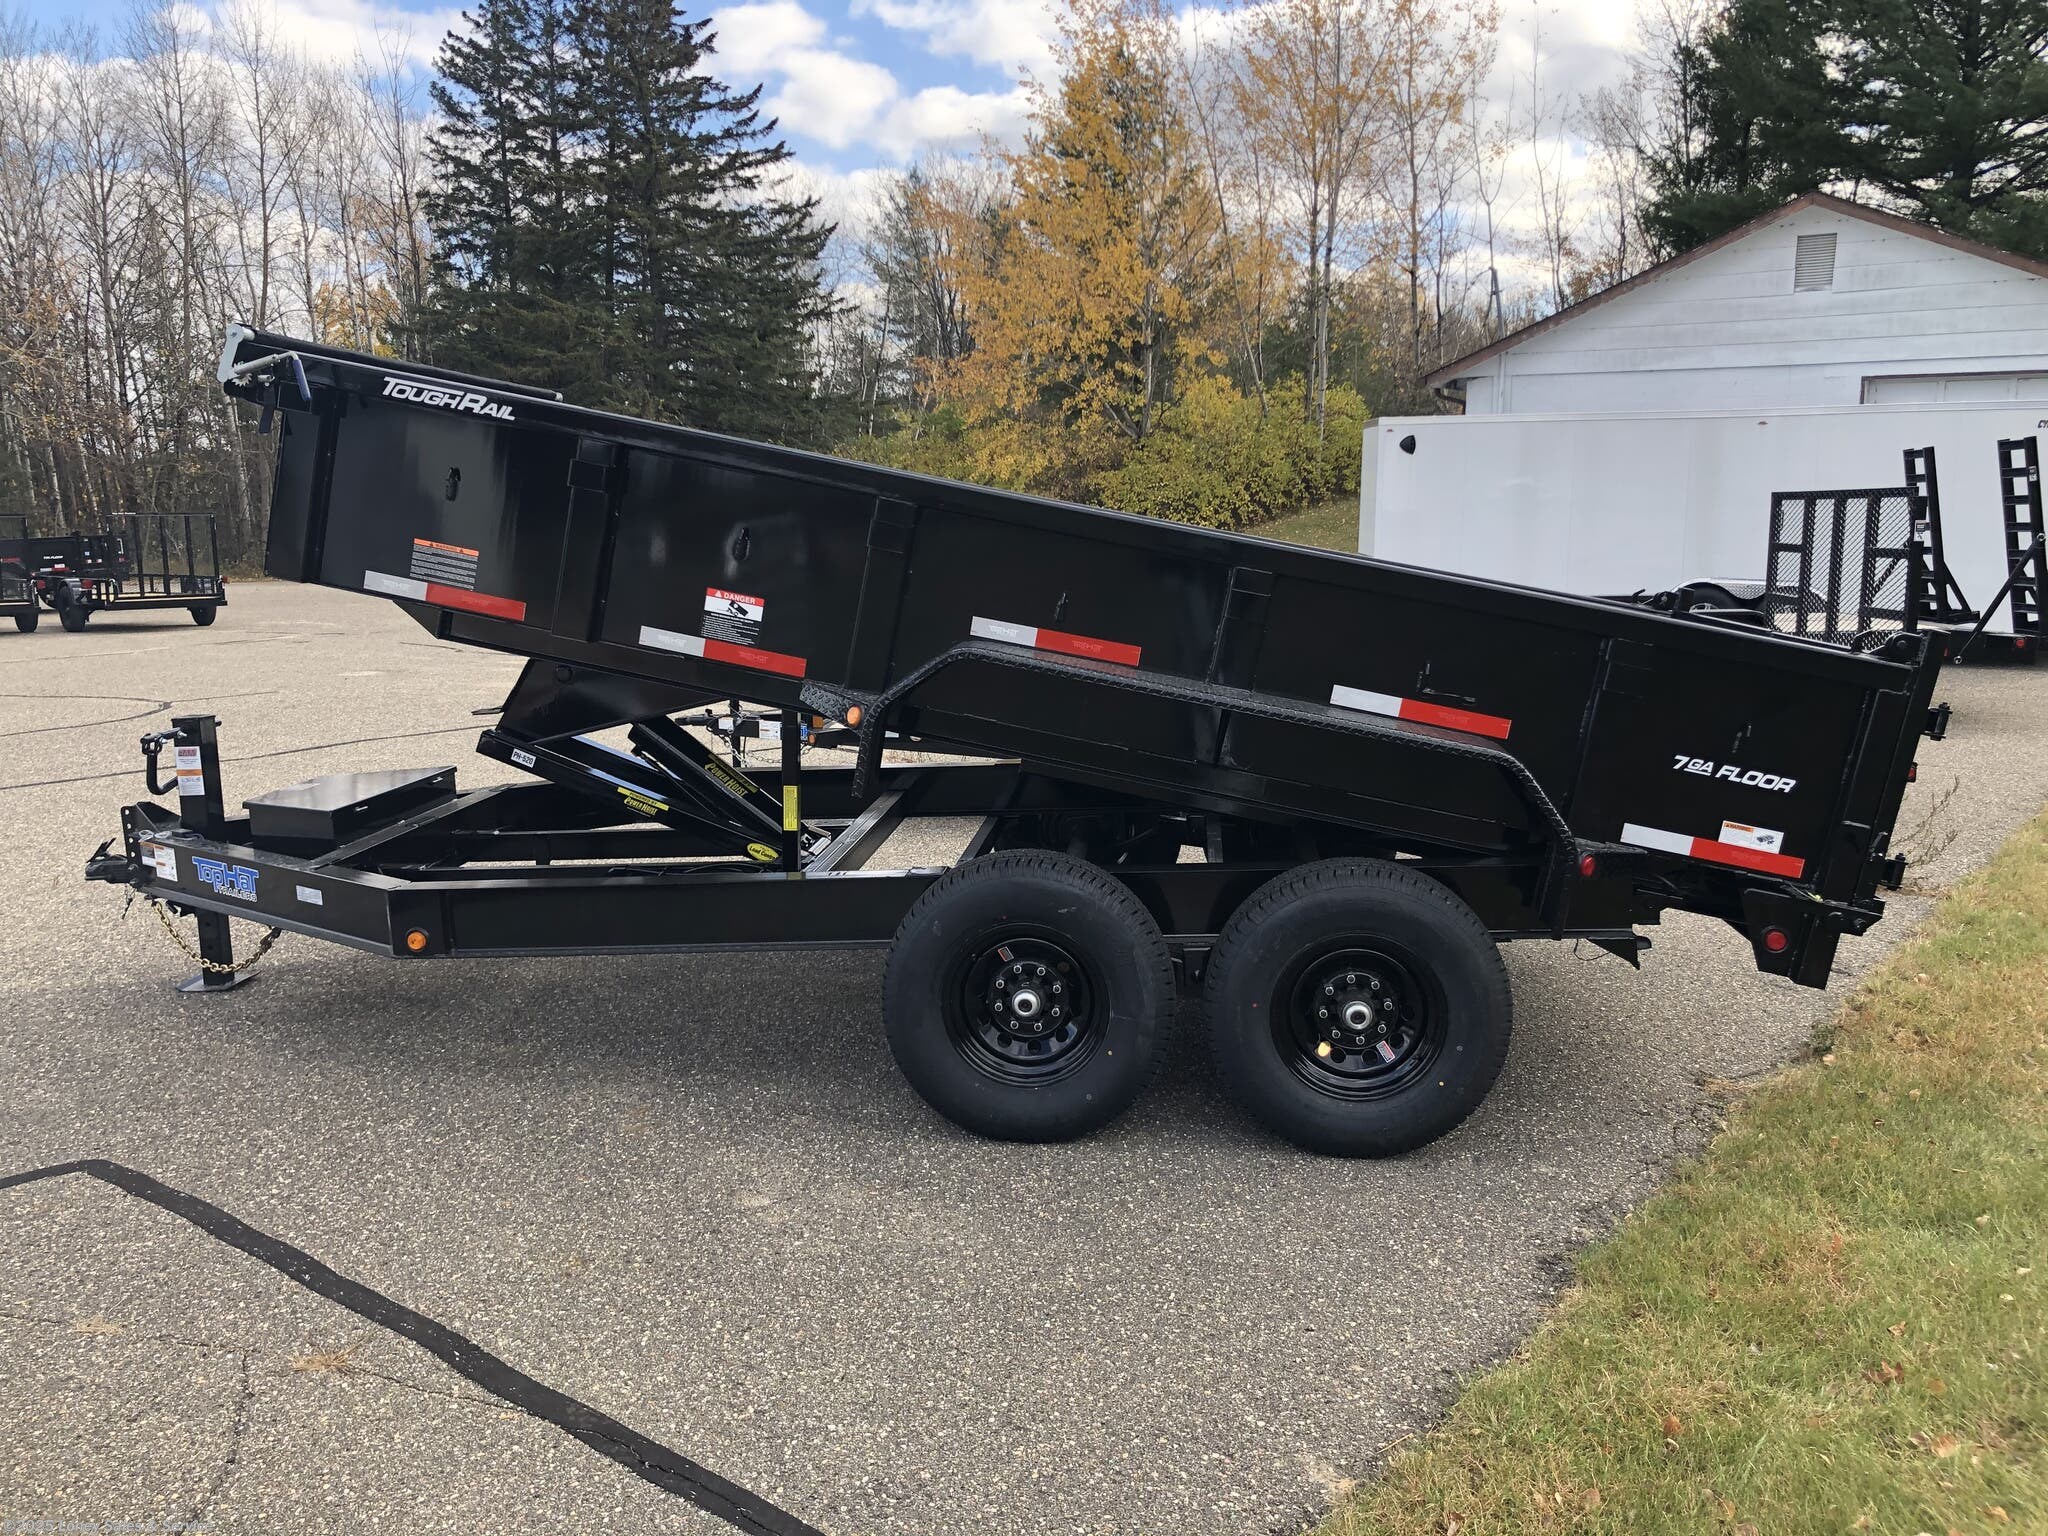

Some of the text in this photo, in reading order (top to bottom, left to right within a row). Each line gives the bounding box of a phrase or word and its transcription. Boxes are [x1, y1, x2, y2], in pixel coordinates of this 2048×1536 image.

[723, 591, 756, 605] DANGER
[704, 762, 730, 784] POWER
[725, 778, 749, 797] HOIST
[1715, 765, 1797, 793] FLOOR
